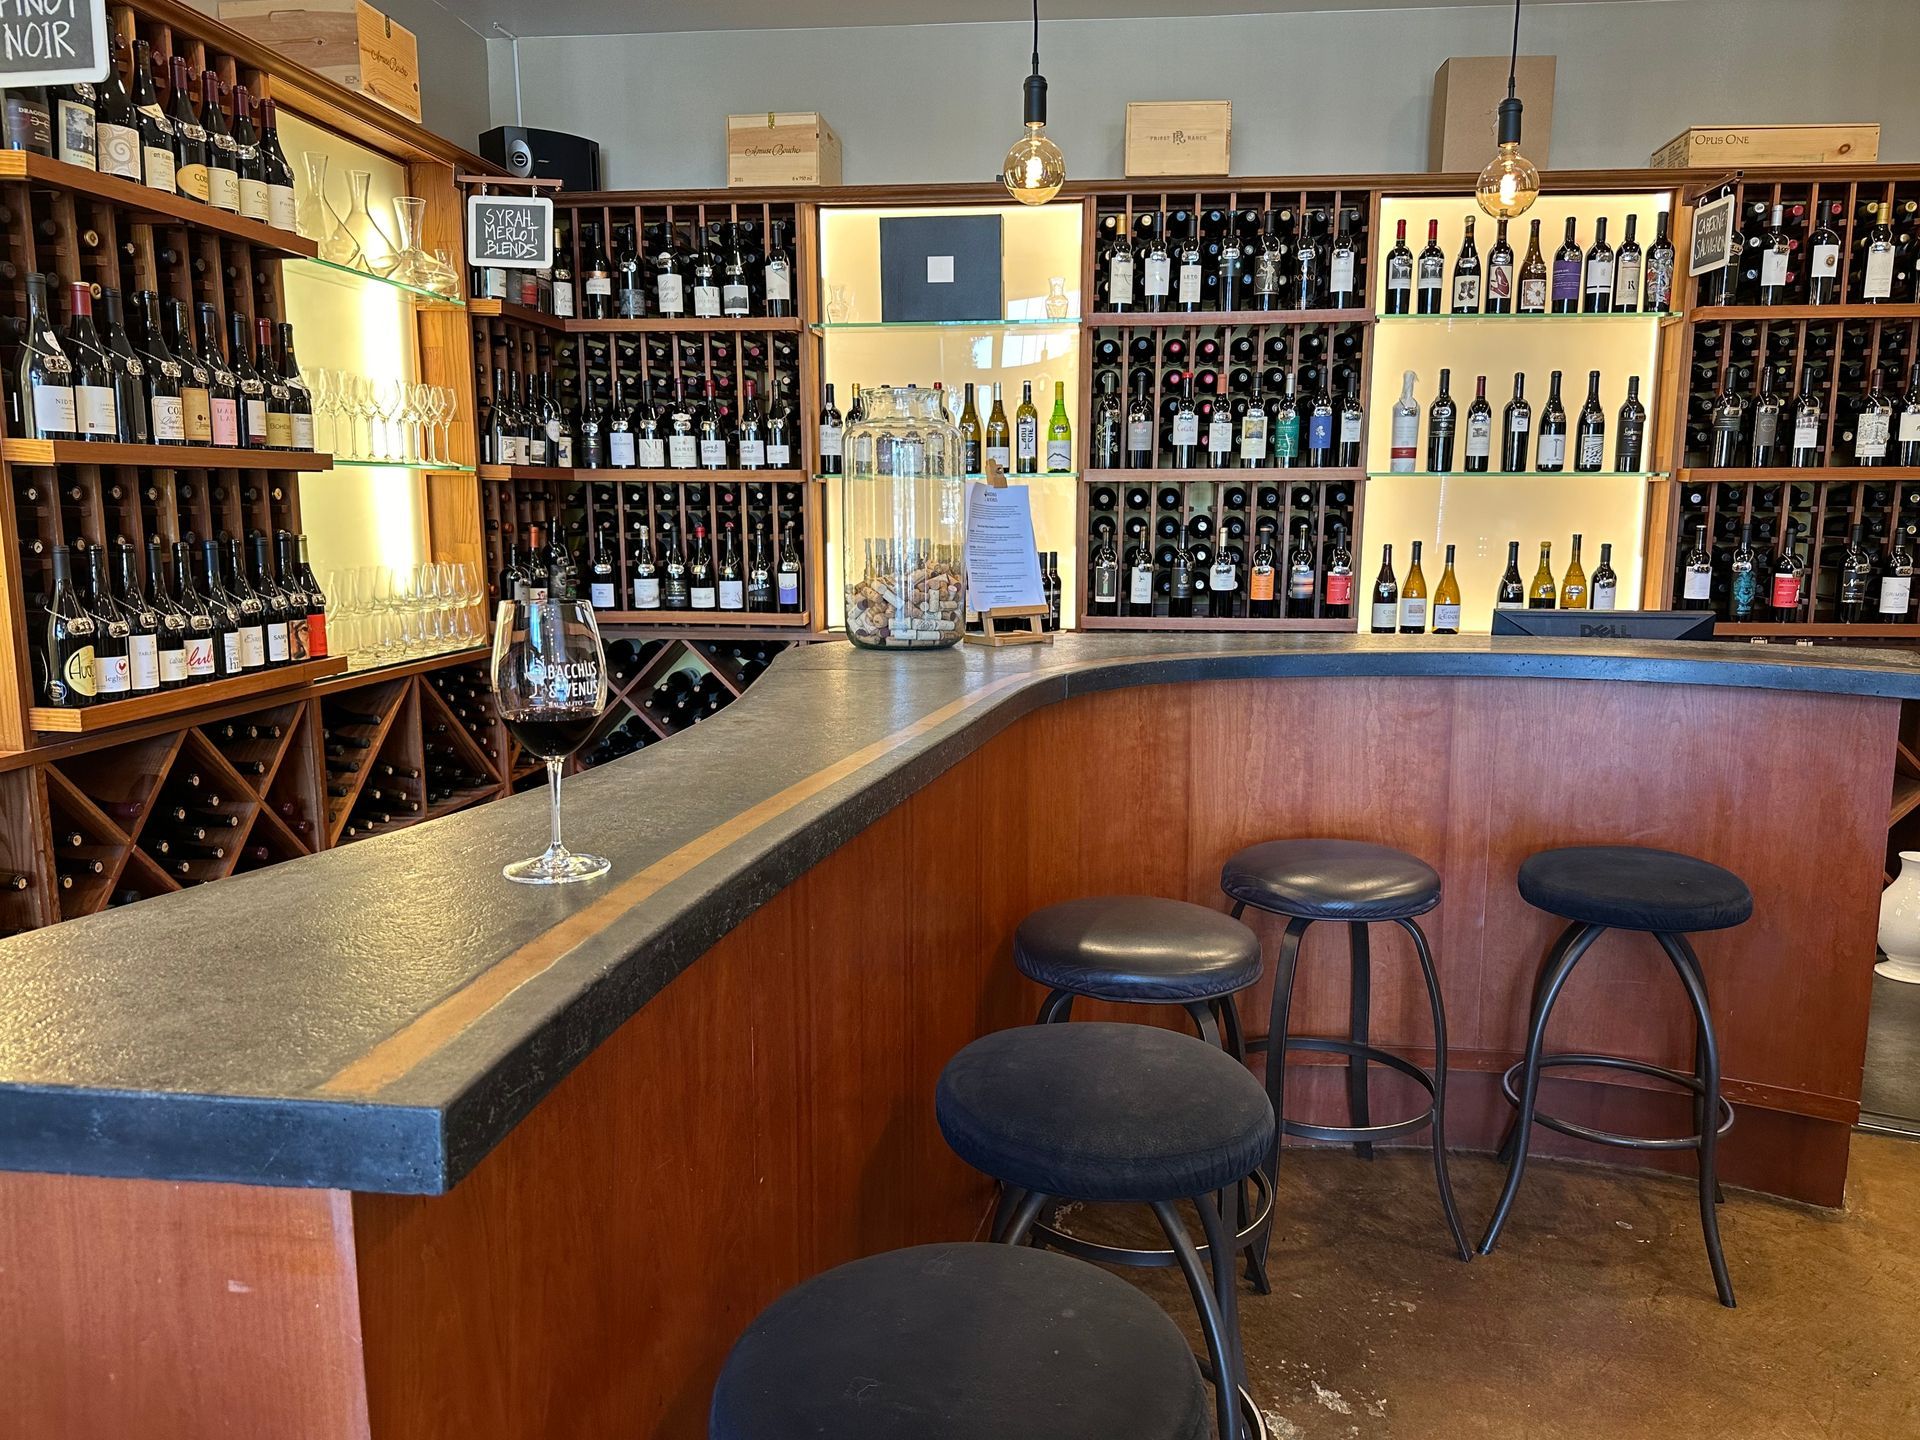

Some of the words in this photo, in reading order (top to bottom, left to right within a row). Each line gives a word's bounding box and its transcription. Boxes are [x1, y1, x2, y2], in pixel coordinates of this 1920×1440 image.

[3, 21, 76, 60] NOIR
[484, 239, 538, 259] BLENDS
[1580, 624, 1632, 638] DELL
[548, 660, 597, 680] BACCHUS
[548, 682, 557, 698] &
[565, 680, 598, 698] VENUS
